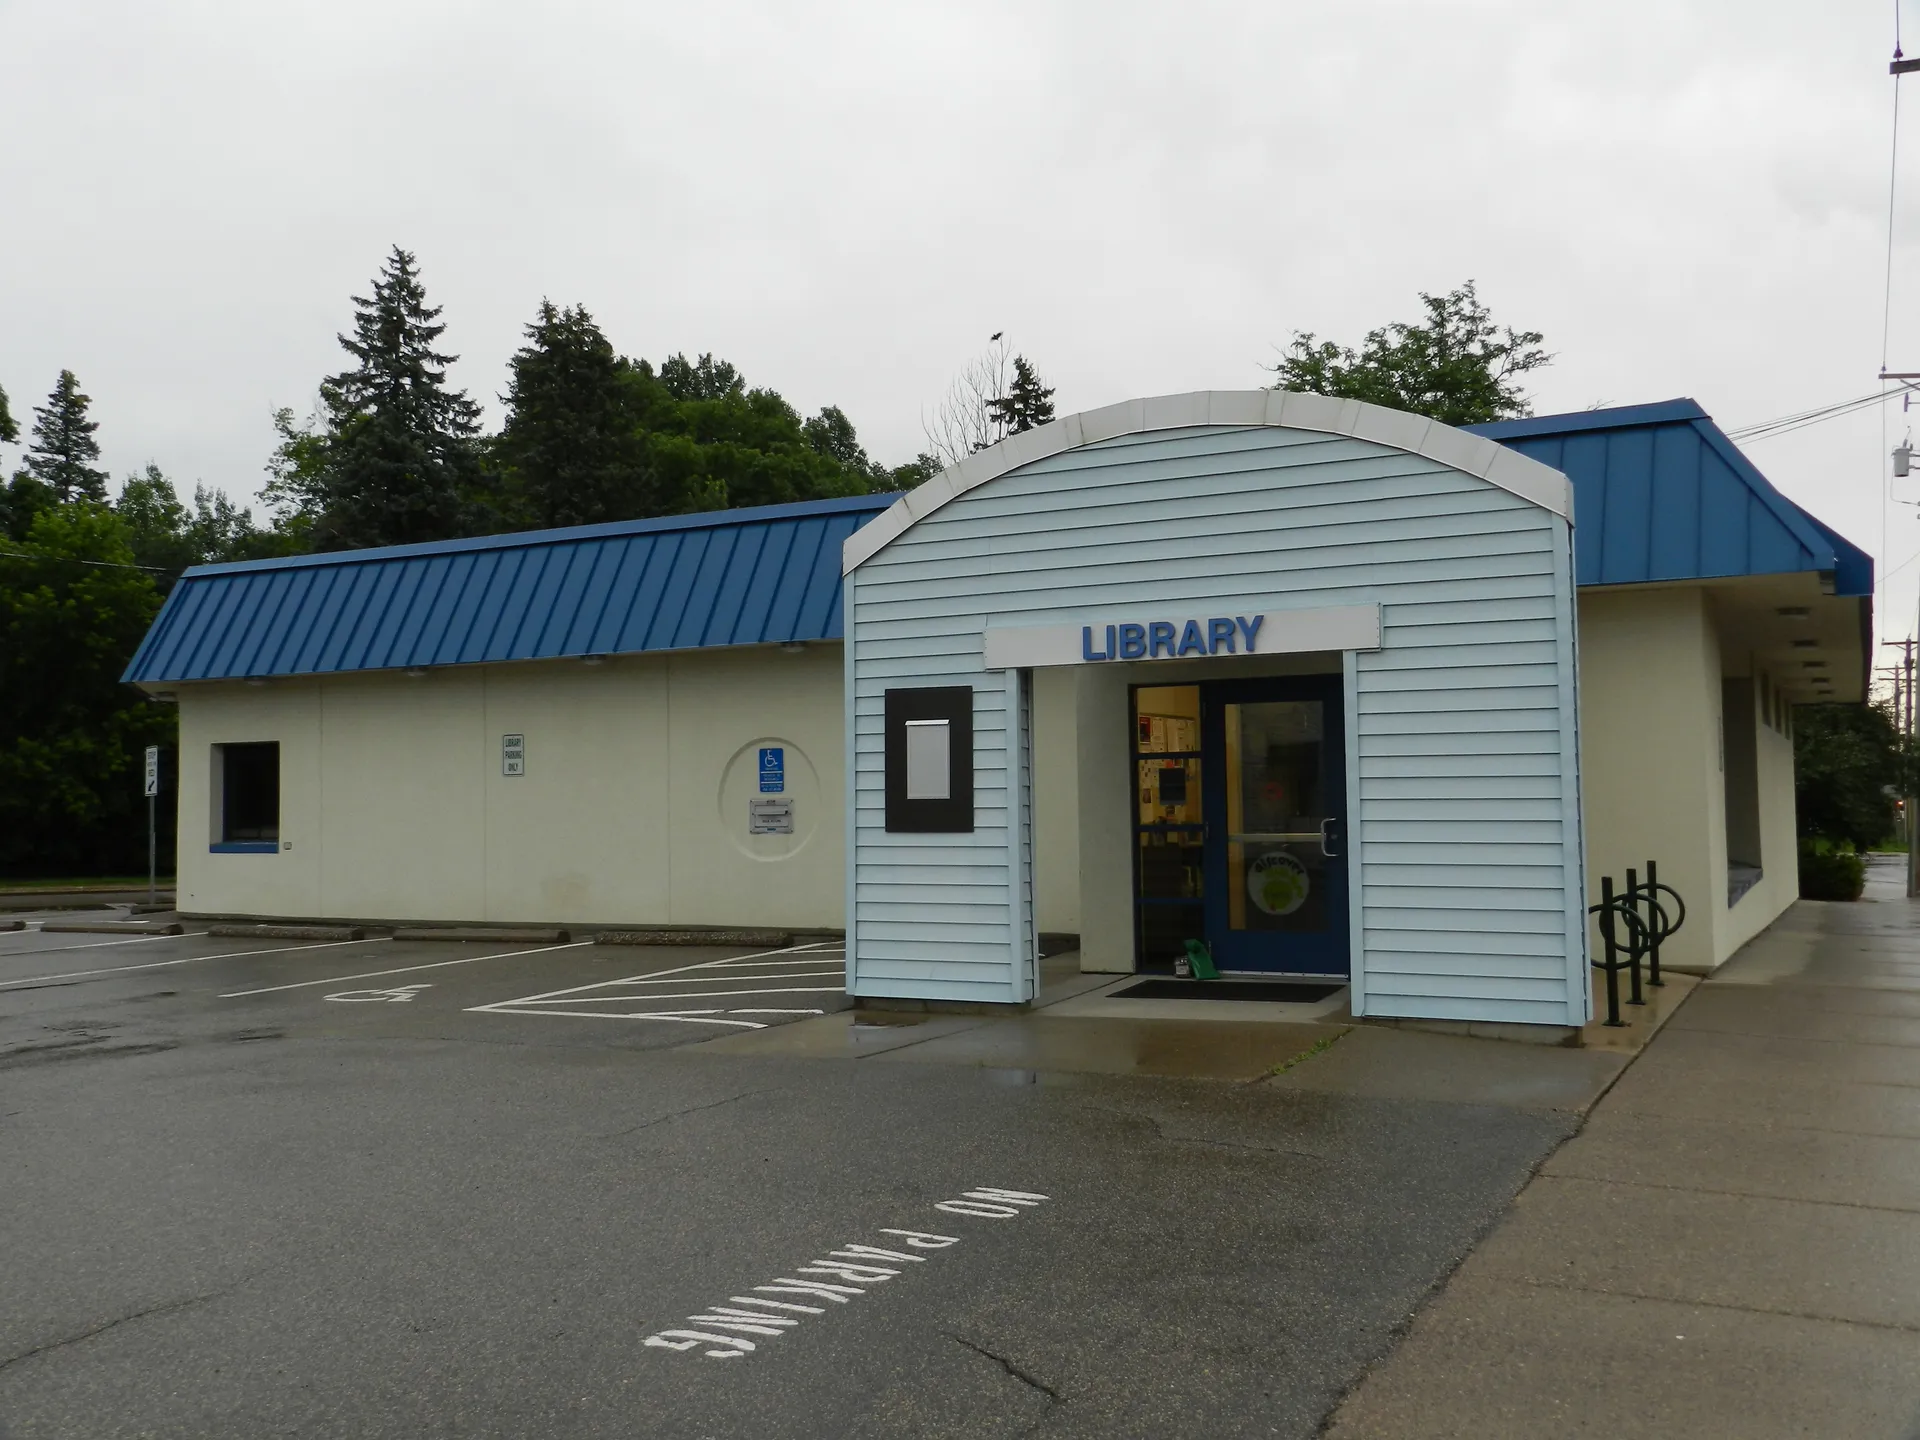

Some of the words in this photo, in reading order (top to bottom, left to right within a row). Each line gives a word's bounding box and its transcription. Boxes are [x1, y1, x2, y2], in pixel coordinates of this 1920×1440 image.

[1082, 615, 1264, 661] LIBRARY
[934, 1186, 1051, 1218] NO
[643, 1228, 961, 1358] PARKING
